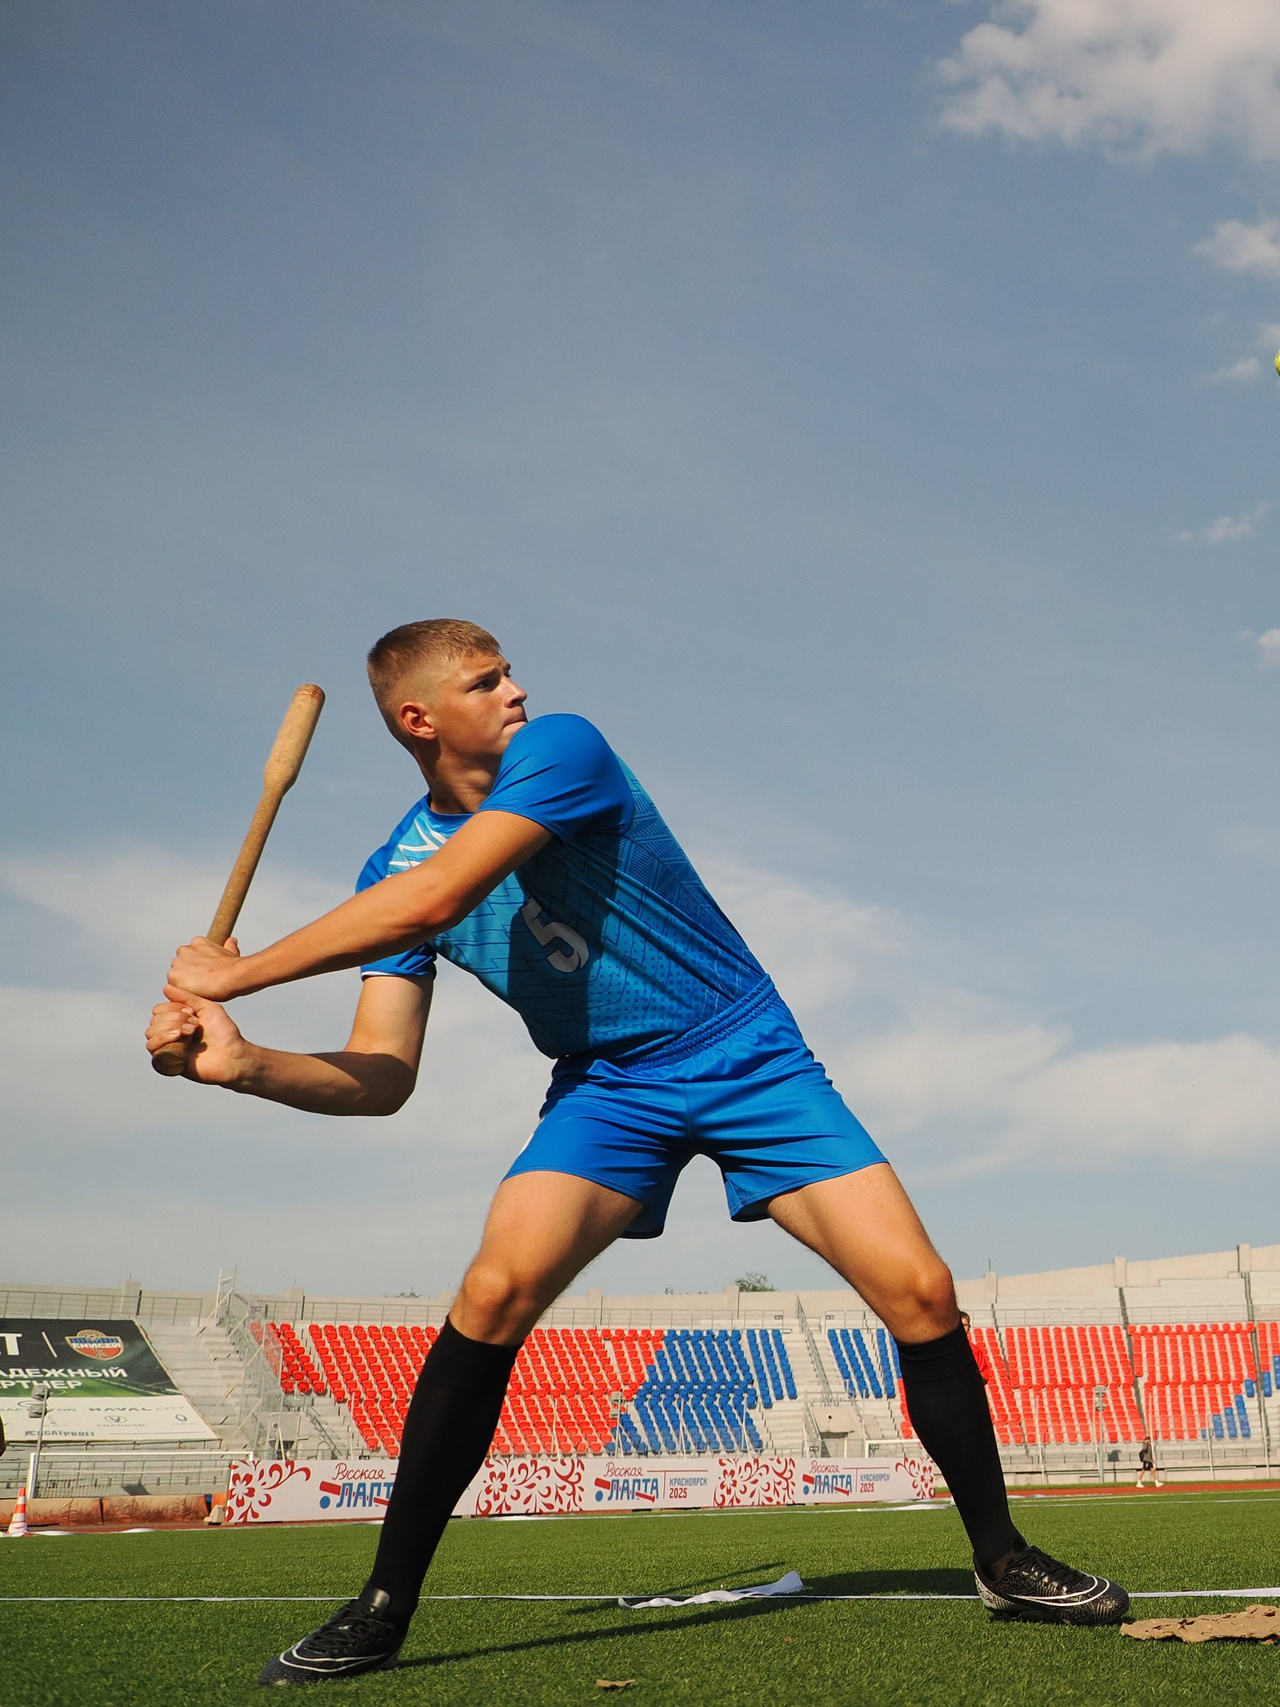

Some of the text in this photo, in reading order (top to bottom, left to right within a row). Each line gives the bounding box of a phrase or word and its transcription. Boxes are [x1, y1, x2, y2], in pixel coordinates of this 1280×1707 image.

[520, 897, 590, 973] 5
[0, 1380, 83, 1389] РТНЕР
[332, 1462, 386, 1481] Русская
[604, 1461, 644, 1478] Русская
[860, 1473, 891, 1482] КРАСНОЯРСК
[608, 1478, 659, 1501] ЛАПТА
[669, 1477, 708, 1486] КРАСНОЯРСК
[812, 1474, 852, 1494] ЛАПТА
[860, 1483, 875, 1493] 2025
[336, 1482, 395, 1508] ЛАПТ
[669, 1487, 688, 1499] 2025
